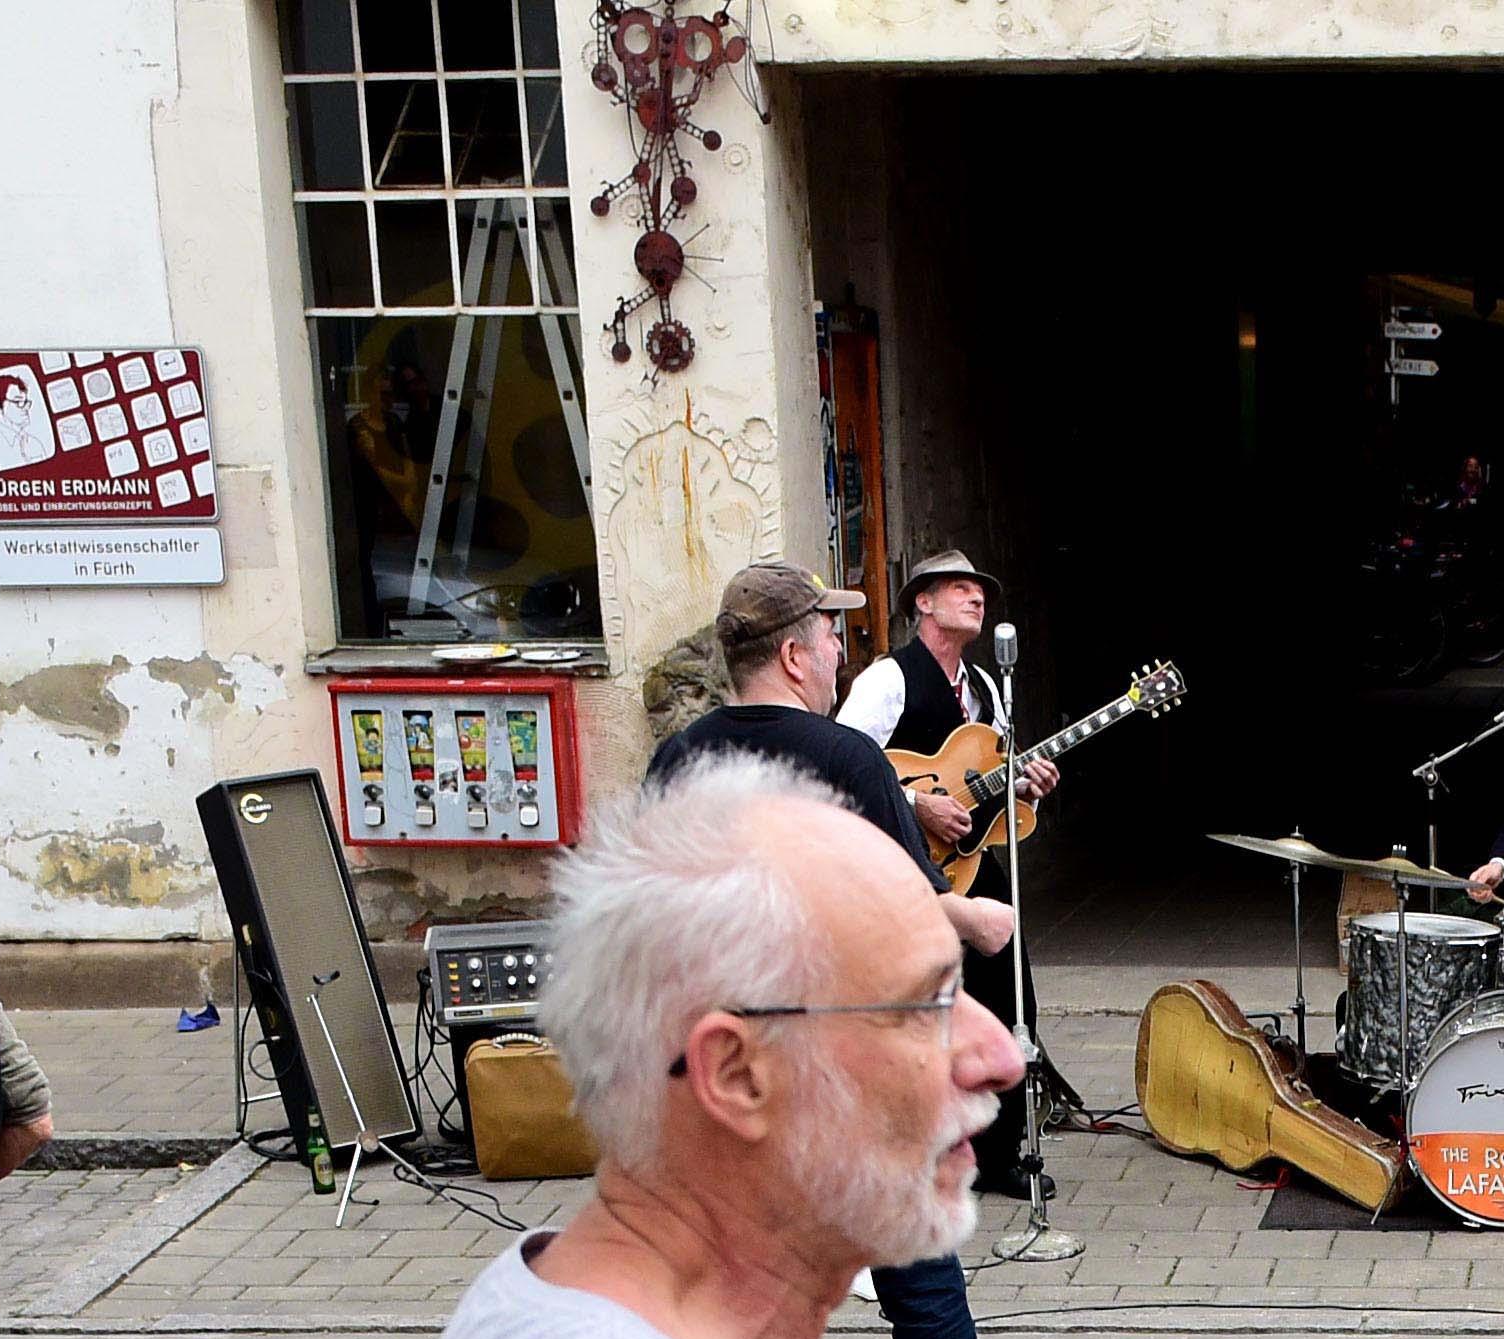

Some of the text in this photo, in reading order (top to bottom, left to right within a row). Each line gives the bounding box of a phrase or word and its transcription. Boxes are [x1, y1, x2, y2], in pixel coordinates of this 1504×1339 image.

[61, 478, 151, 496] ERDMANN
[22, 501, 41, 511] UND
[43, 500, 153, 511] EINRICHTUNGSKONZEPTE
[4, 538, 200, 555] Werkstattwissenschaftler
[74, 561, 135, 576] in Fürth
[1440, 1147, 1469, 1163] THE
